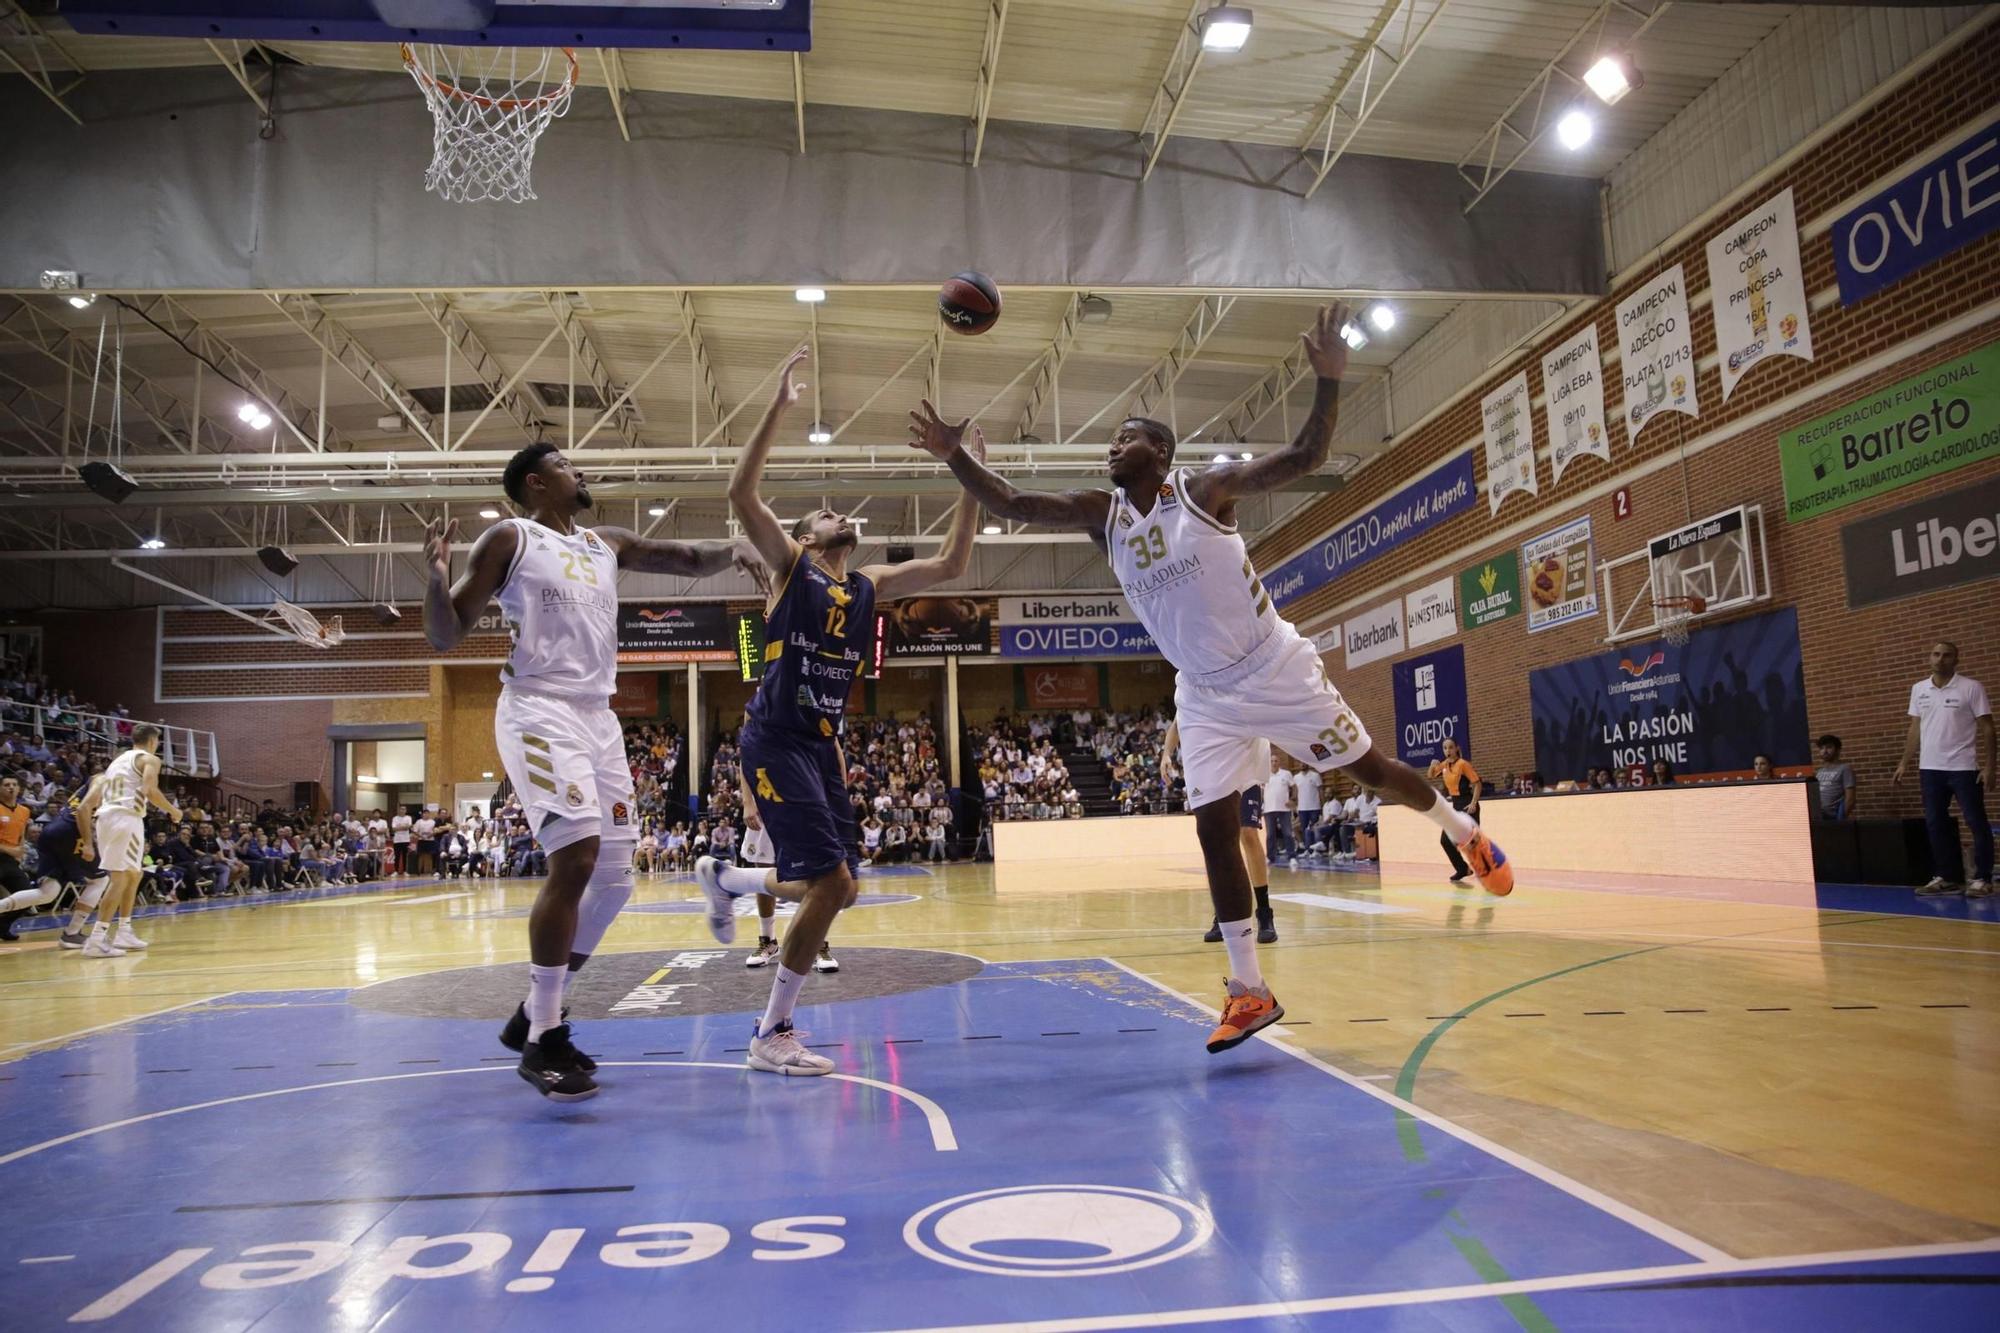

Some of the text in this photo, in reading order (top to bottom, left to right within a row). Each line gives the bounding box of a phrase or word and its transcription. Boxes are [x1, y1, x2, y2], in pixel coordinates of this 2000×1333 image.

[1848, 137, 2000, 274] OVIE
[1724, 212, 1777, 255] CAMPEON
[1739, 248, 1768, 274] COPA
[1729, 267, 1783, 307] PRINCESA
[1622, 281, 1677, 328] CAMPEON
[1745, 300, 1772, 326] 16/17
[1630, 317, 1676, 357] ADECCO
[1547, 338, 1592, 377] CAMPEON
[1624, 344, 1691, 392] PLATA 12/13
[1552, 370, 1593, 404] LIGA EBA
[1895, 362, 1980, 407] FUNCIONAL
[1563, 404, 1587, 427] 09/10
[1841, 398, 1971, 471] Barreto
[1616, 490, 1627, 516] 2
[1324, 476, 1468, 571] OVIEDO capital del deporte
[1669, 520, 1721, 550] La Nueva España
[1128, 525, 1167, 570] 33
[558, 552, 598, 587] 25
[1022, 601, 1120, 618] Liberbank
[1469, 590, 1512, 615] CAJA RURAL
[1548, 607, 1560, 620] 985
[1560, 603, 1572, 617] 212
[1572, 600, 1583, 614] 411
[826, 606, 846, 638] 12
[1015, 627, 1119, 650] OVIEDO
[1348, 617, 1399, 655] Liberbank
[896, 645, 909, 653] LA
[913, 643, 942, 653] PASIÓN
[1630, 691, 1645, 702] Desde
[1318, 713, 1359, 755] 33
[1405, 716, 1454, 747] OVIEDO
[1603, 708, 1694, 744] LA PASIÓN
[1613, 742, 1687, 769] NOS UNE
[1631, 769, 1644, 787] 5
[608, 983, 698, 1012] bank
[66, 1215, 847, 1323] seidel
